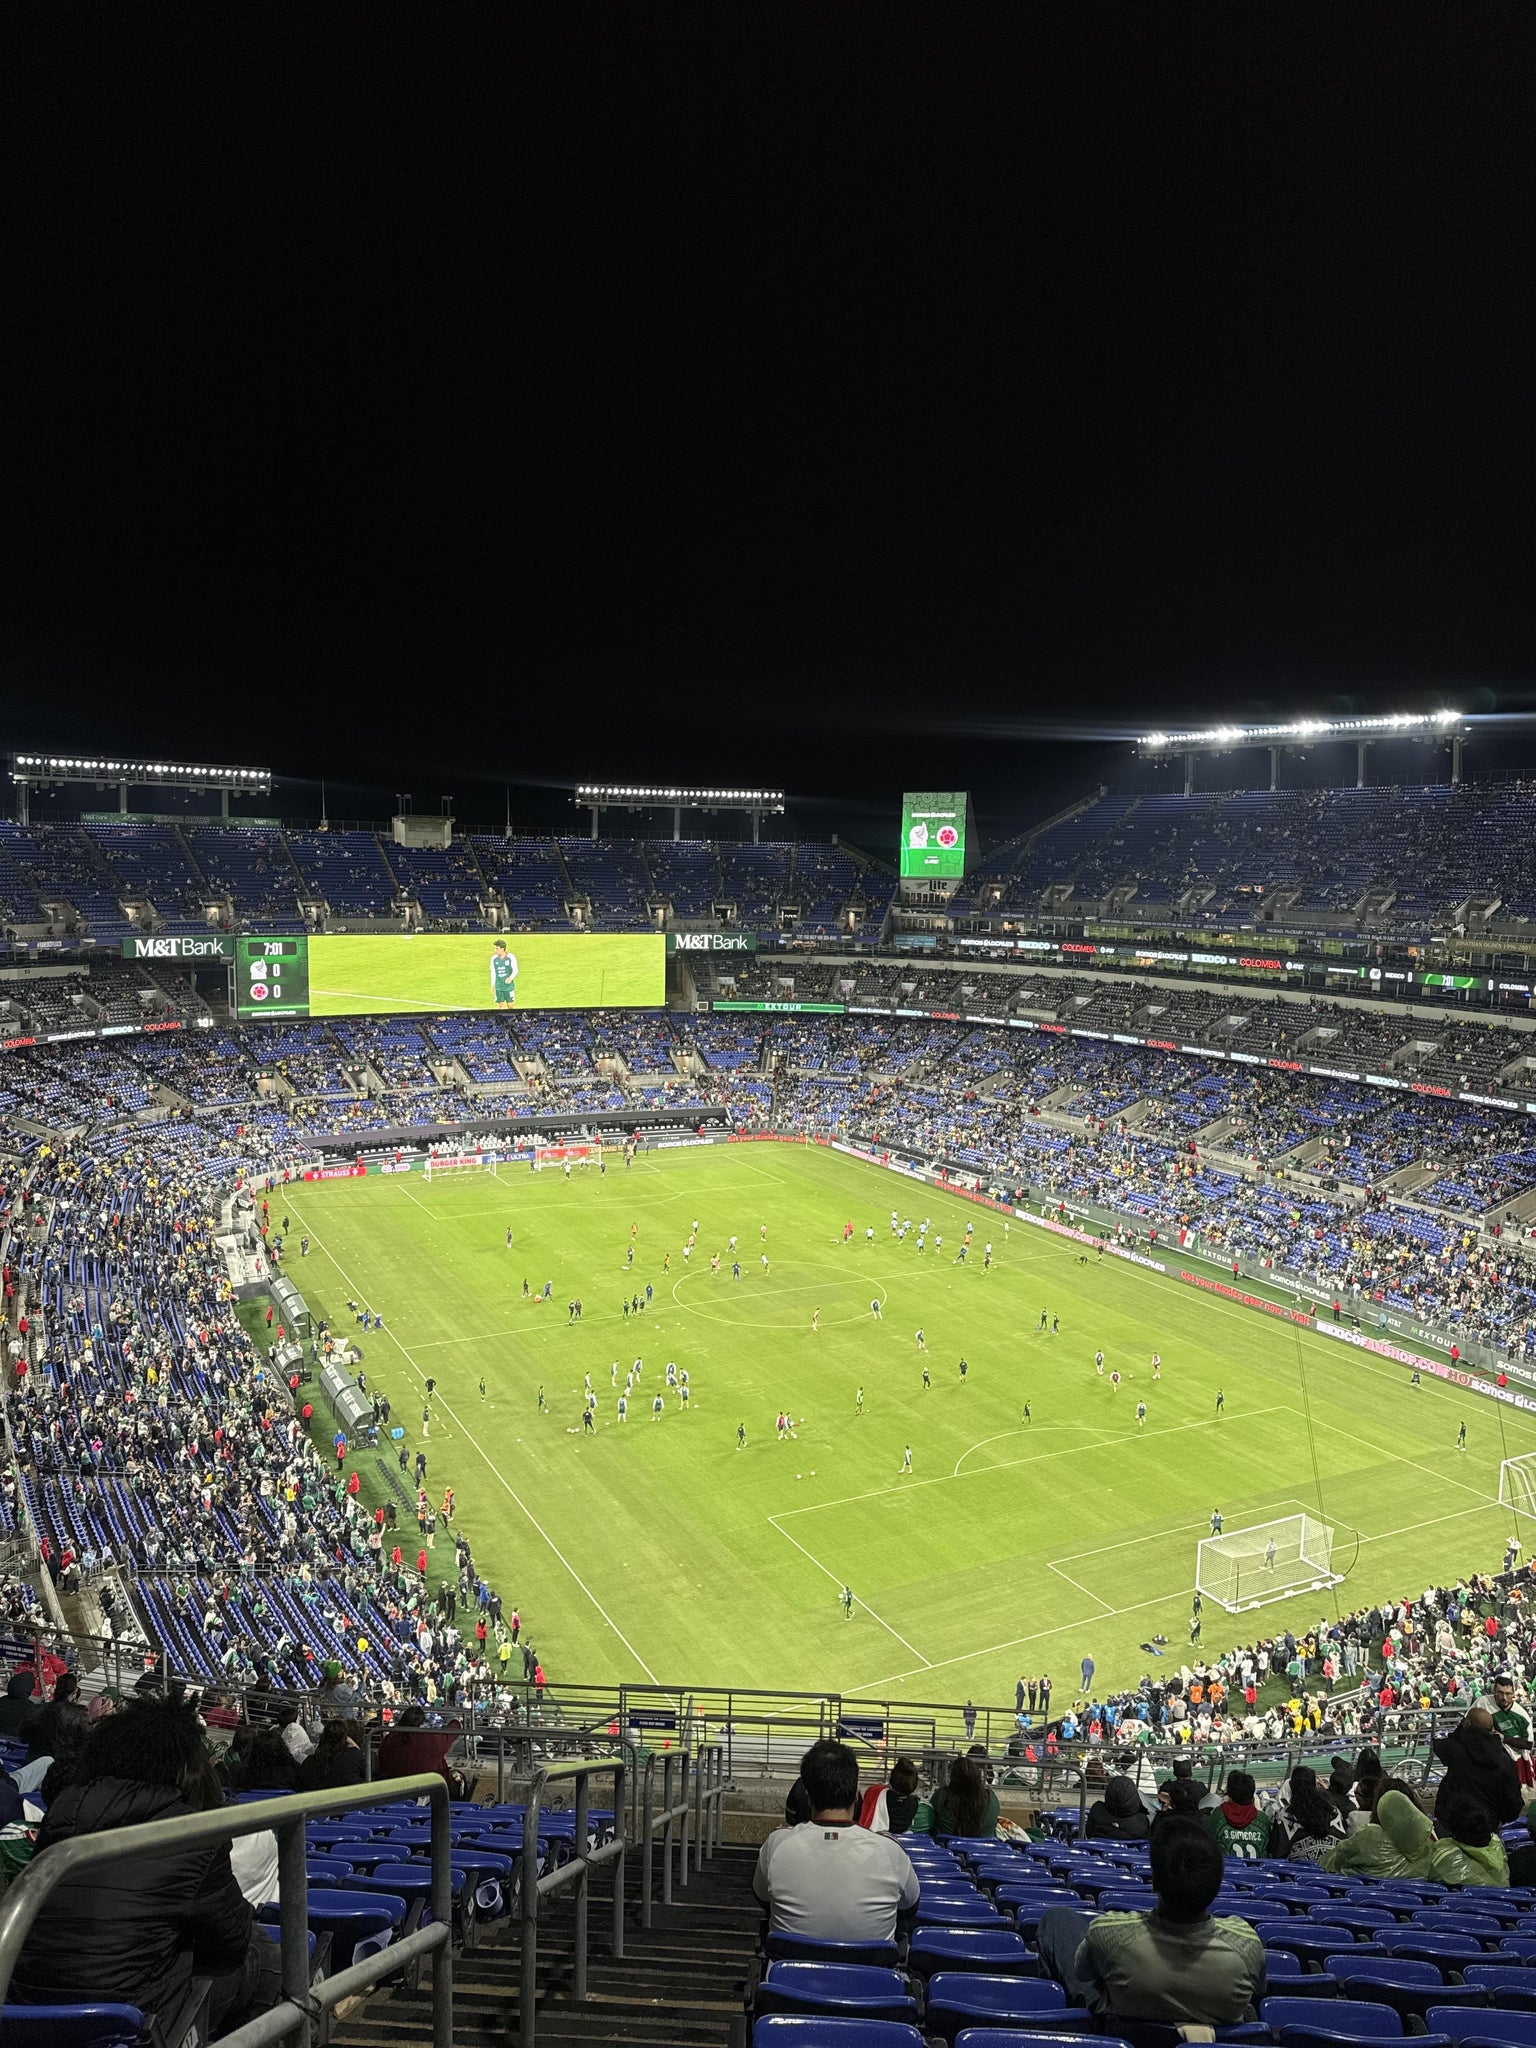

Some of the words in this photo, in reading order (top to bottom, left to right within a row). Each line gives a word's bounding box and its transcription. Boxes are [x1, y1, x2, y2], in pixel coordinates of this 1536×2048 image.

[929, 880, 947, 892] Lite
[134, 939, 181, 957] M&T
[182, 938, 224, 956] Bank
[264, 942, 283, 955] 7:01
[675, 934, 713, 950] M&T
[713, 935, 748, 950] Bank
[1017, 940, 1050, 950] MEXICO
[1062, 943, 1097, 953] COLOMBIA
[1456, 941, 1482, 949] JONATHAN
[1135, 951, 1158, 959] SOMOS
[1163, 953, 1188, 961] LOCALES
[1192, 953, 1227, 964] MEXICO
[1239, 957, 1282, 969] COLOMBIA
[273, 963, 280, 977] 0
[1442, 975, 1454, 986] 7:01
[273, 985, 281, 998] 0
[1499, 983, 1529, 992] COLOMBIA
[931, 1011, 960, 1020] COLOMBIA
[102, 1025, 134, 1036] MEXICO
[144, 1022, 182, 1032] COLOMBIA
[1040, 1023, 1066, 1033] COLOMBIA
[3, 1037, 36, 1048] COLOMBIA
[1147, 1039, 1176, 1050] COLOMBIA
[1268, 1058, 1303, 1071] COLOMBIA
[1309, 1066, 1331, 1076] SOMOS
[1336, 1070, 1360, 1081] LOCALES
[1366, 1074, 1400, 1088] MEXICO
[1411, 1082, 1451, 1097] COLOMBIA
[1459, 1092, 1484, 1103] SOMOS
[1490, 1097, 1519, 1109] LOCALES
[739, 1135, 753, 1143] your
[779, 1135, 795, 1143] gear
[430, 1158, 458, 1168] BURGER
[460, 1156, 477, 1165] KING
[510, 1153, 530, 1161] ULTRA
[320, 1169, 350, 1178] STRAUSS
[1106, 1243, 1131, 1260] SOMOS
[1134, 1253, 1165, 1272] LOCALES
[1269, 1273, 1296, 1288] SOMOS
[1300, 1283, 1330, 1300] LOCALES
[1180, 1270, 1194, 1282] Get
[1195, 1277, 1214, 1291] your
[1215, 1281, 1242, 1300] Mexico
[1243, 1294, 1264, 1308] gear
[1264, 1303, 1283, 1316] now
[1290, 1310, 1310, 1326] Visit
[1387, 1317, 1402, 1328] AT&T
[1496, 1360, 1532, 1380] SOMOS
[1472, 1379, 1514, 1404] SOMOS
